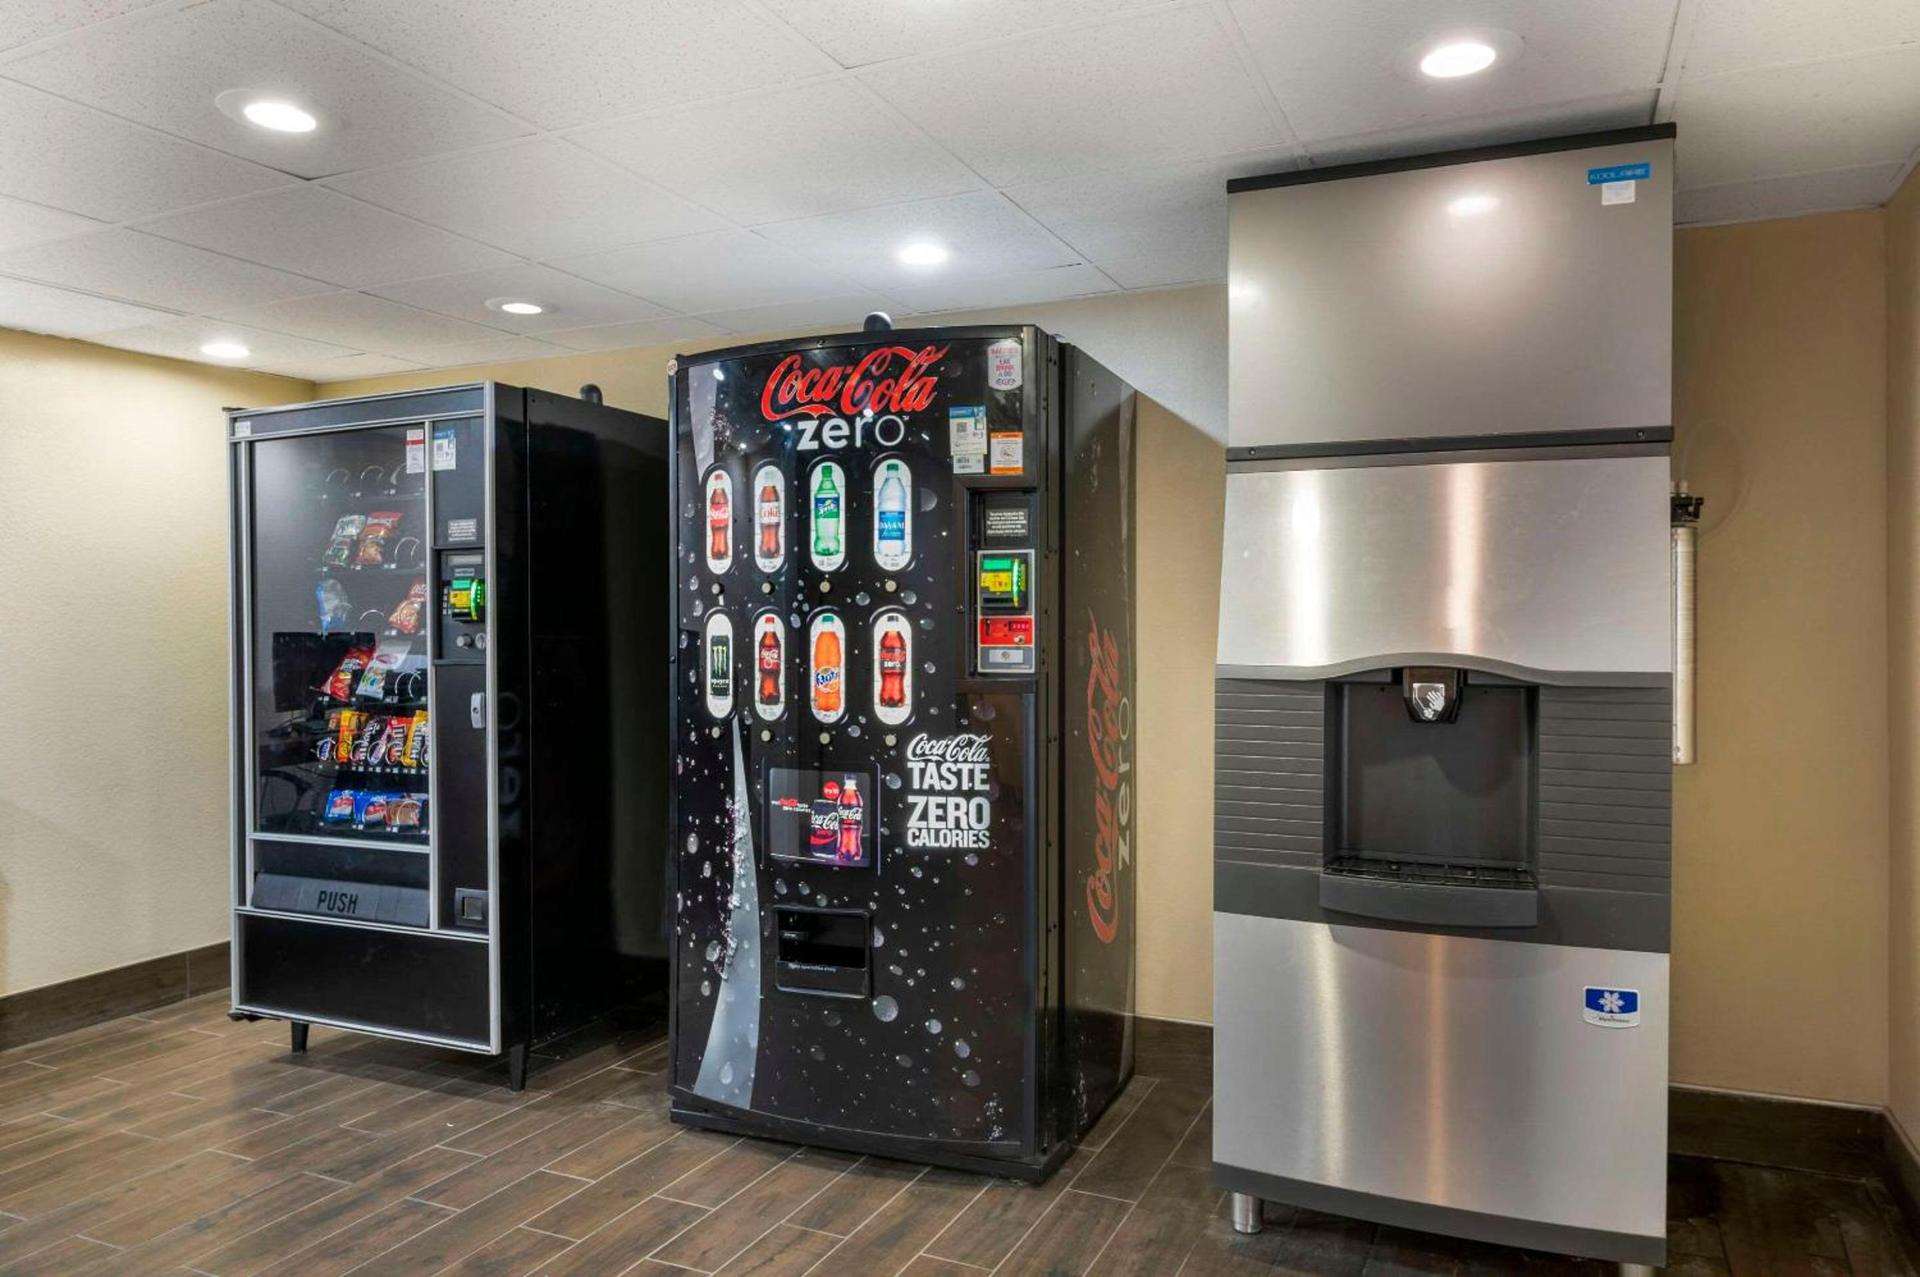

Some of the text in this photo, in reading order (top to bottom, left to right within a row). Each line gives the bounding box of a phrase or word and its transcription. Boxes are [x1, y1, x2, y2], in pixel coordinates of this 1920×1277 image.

[761, 345, 950, 421] Coca-Cola
[797, 415, 905, 450] zero
[907, 733, 993, 762] Coca-Cola
[907, 762, 990, 790] TASTE
[1118, 697, 1130, 870] zero
[907, 796, 991, 830] ZERO
[907, 828, 990, 848] CALORIES
[317, 890, 359, 915] PUSH
